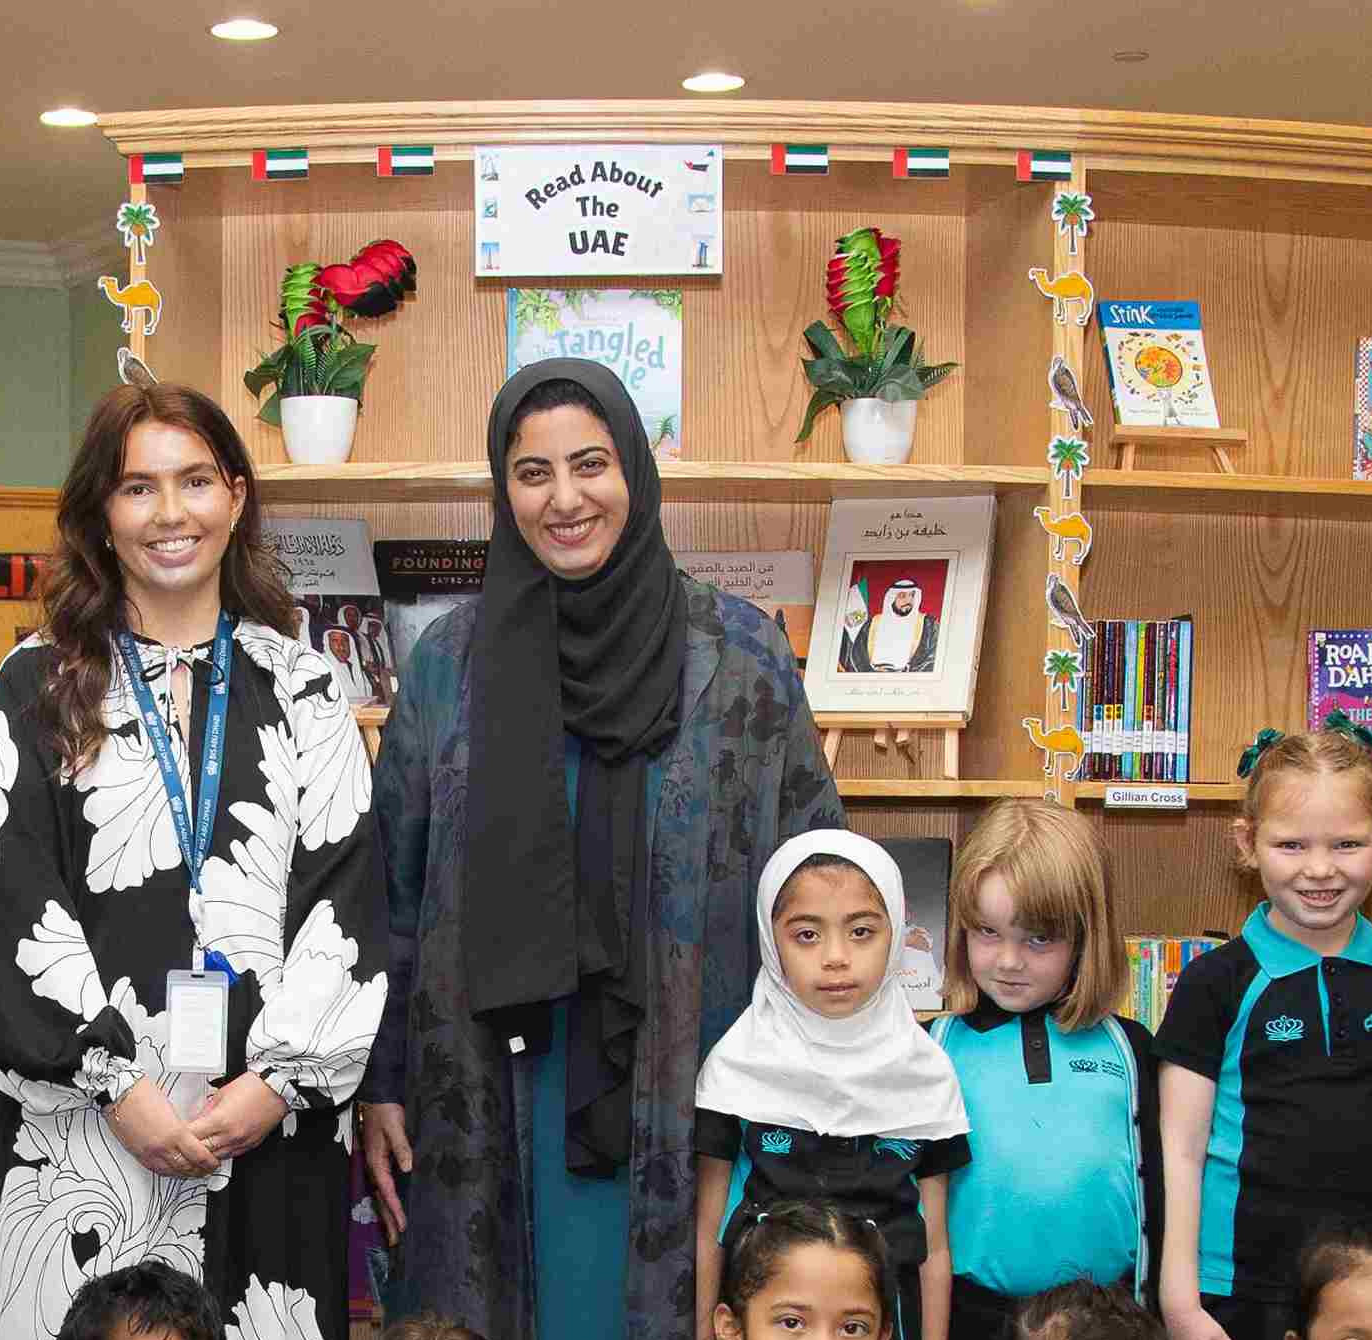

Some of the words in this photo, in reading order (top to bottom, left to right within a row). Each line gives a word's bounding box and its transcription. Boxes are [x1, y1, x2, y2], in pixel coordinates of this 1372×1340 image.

[525, 164, 586, 210] Read
[590, 161, 664, 198] About
[575, 195, 620, 218] The
[568, 230, 629, 257] UAE
[554, 321, 666, 370] Tangled
[1348, 708, 1372, 721] THE
[1112, 791, 1148, 802] Gillian
[1151, 792, 1183, 803] Cross
